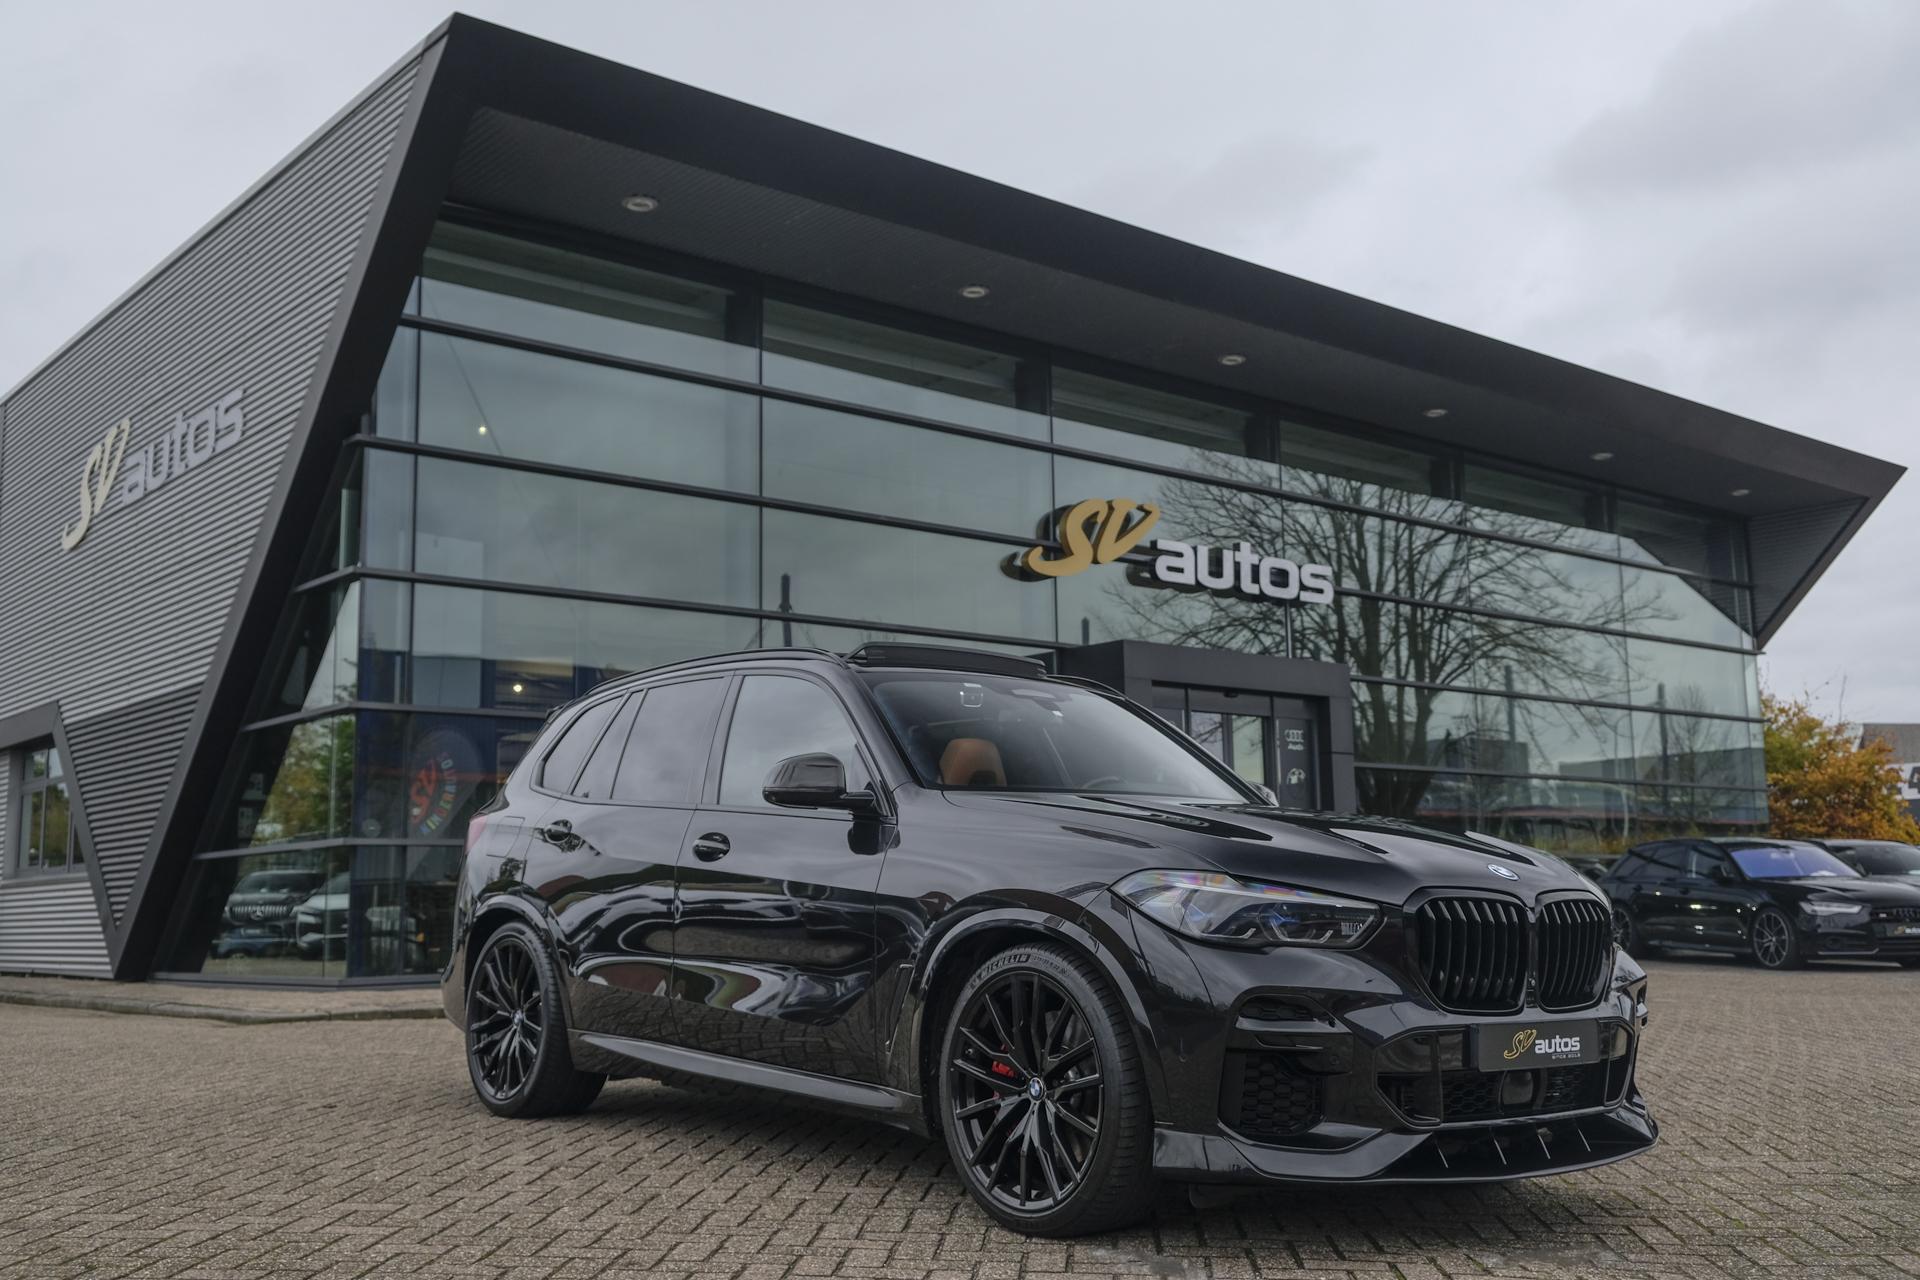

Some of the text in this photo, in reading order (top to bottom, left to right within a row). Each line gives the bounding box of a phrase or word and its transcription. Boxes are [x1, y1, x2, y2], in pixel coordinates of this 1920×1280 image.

[61, 388, 244, 551] SV autos
[1027, 497, 1335, 604] SV autos
[1503, 1029, 1581, 1059] SV autos
